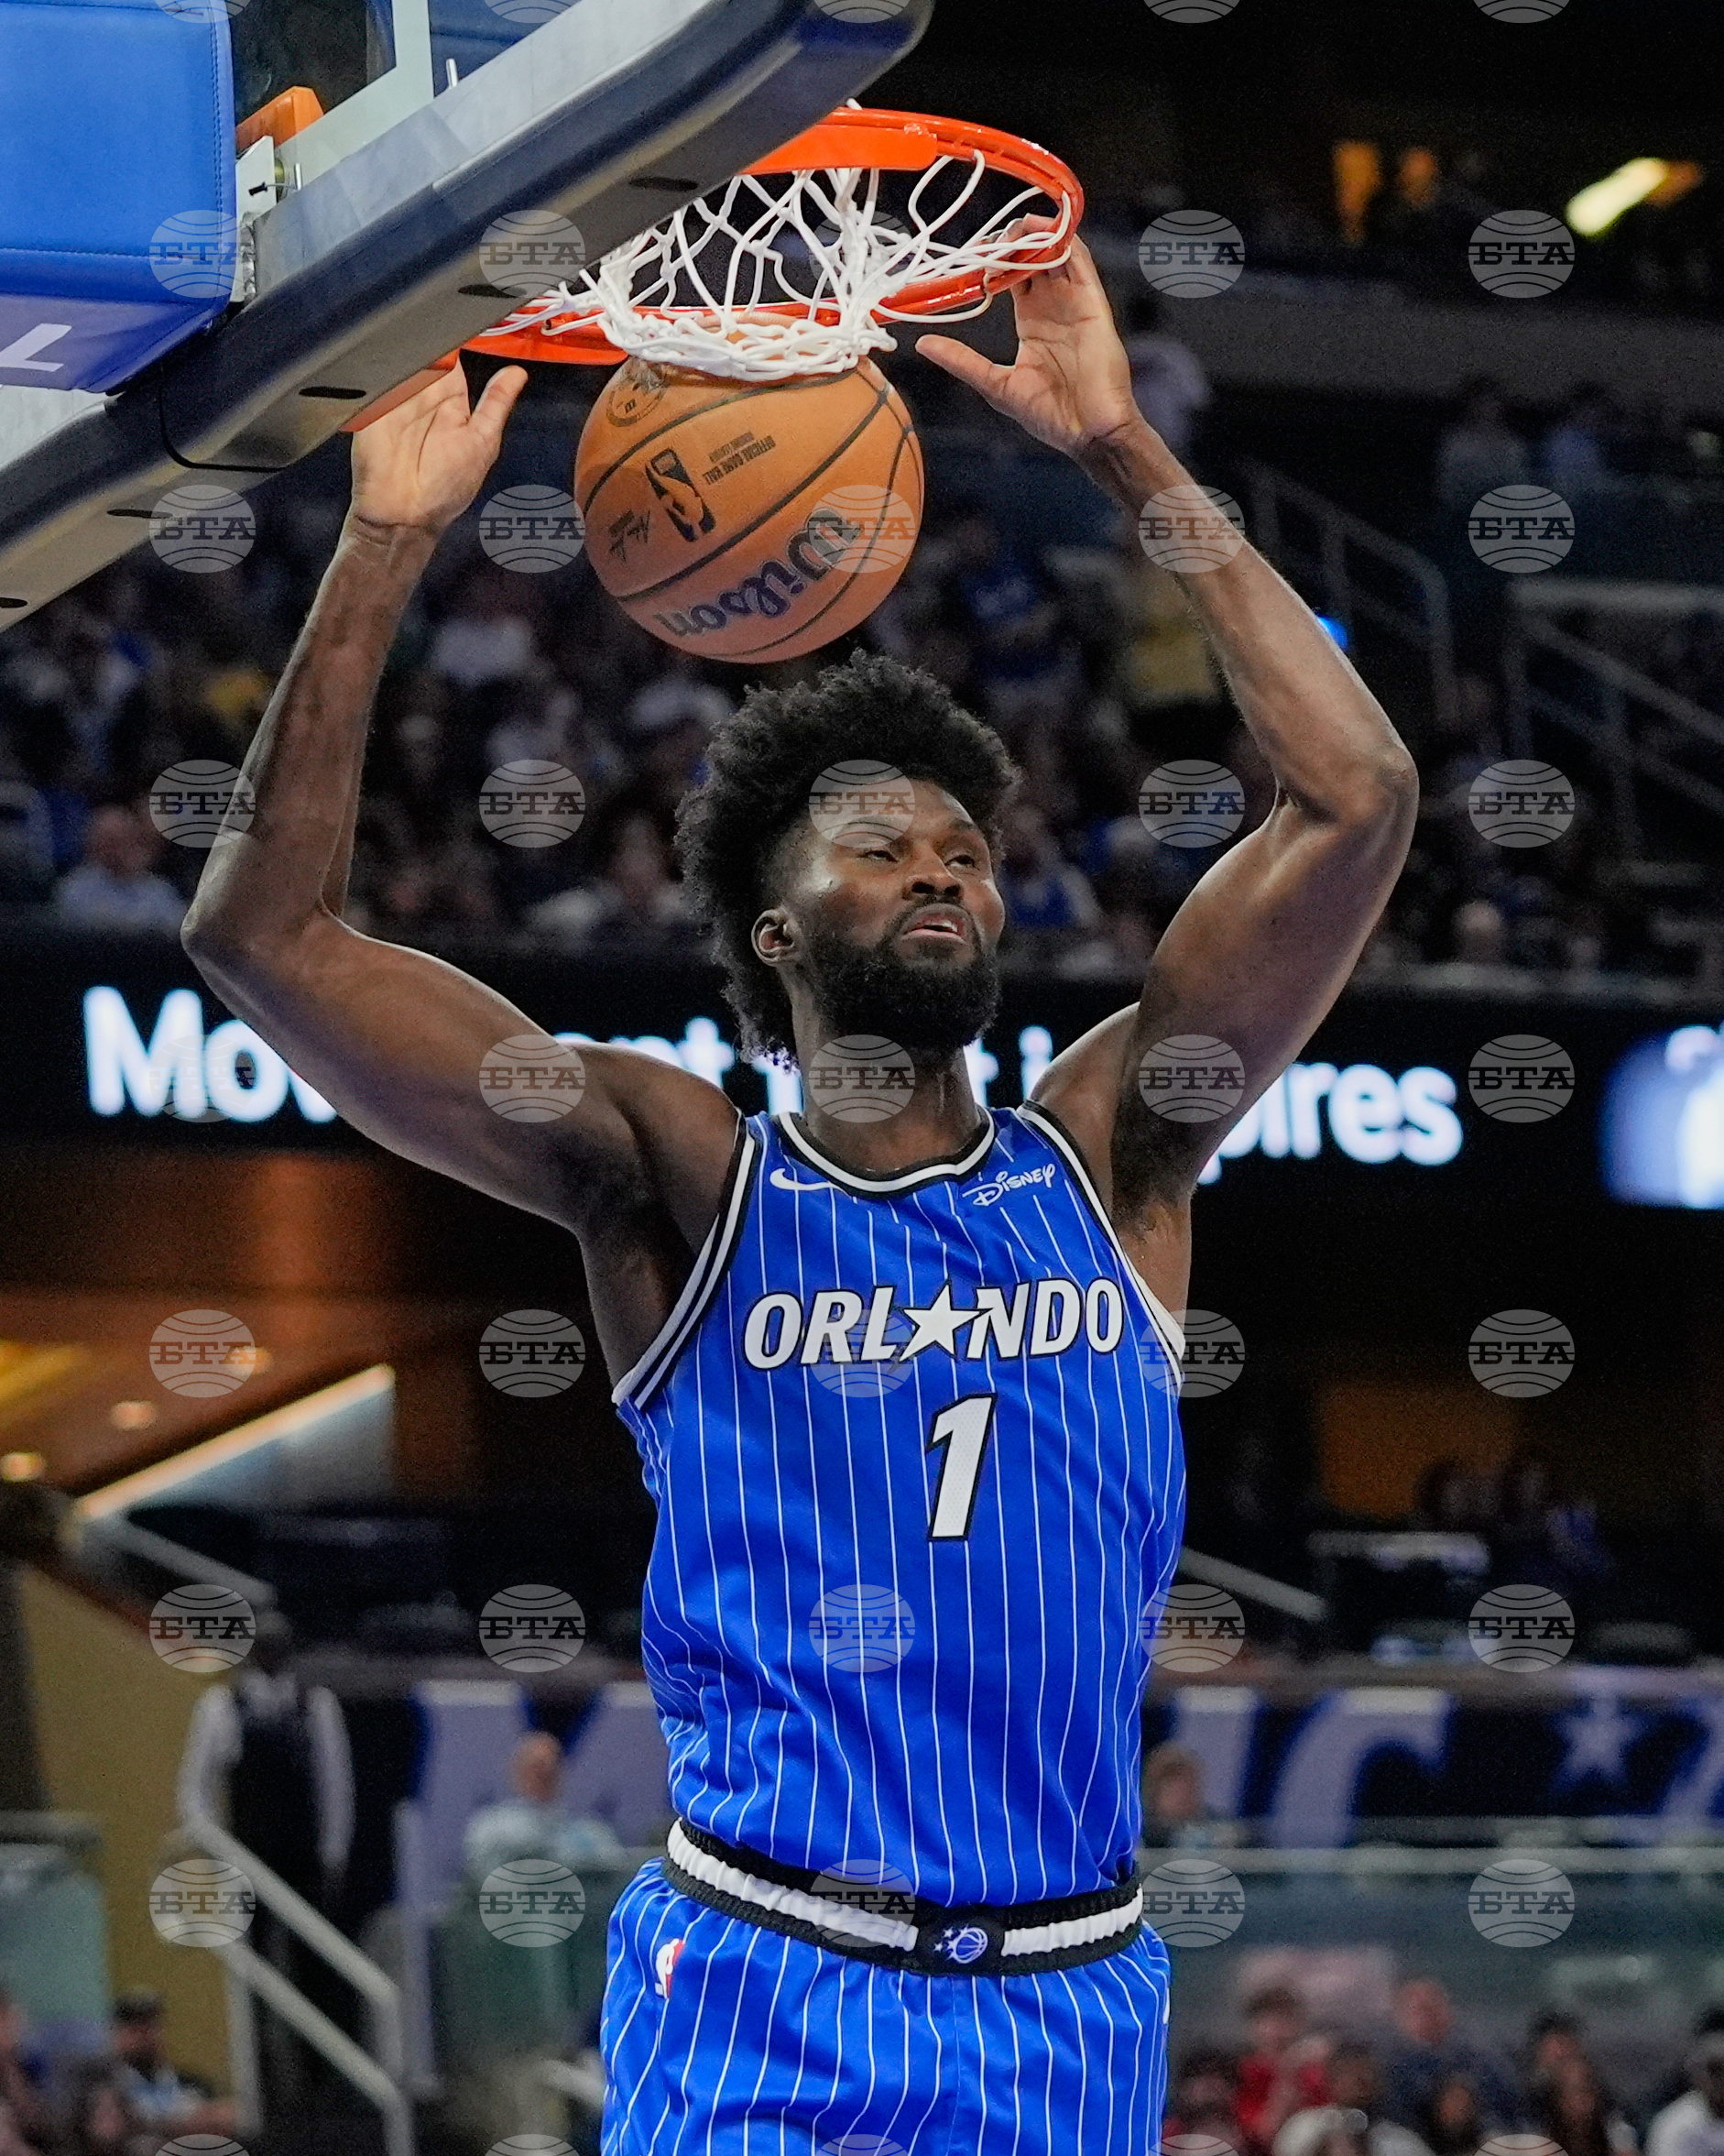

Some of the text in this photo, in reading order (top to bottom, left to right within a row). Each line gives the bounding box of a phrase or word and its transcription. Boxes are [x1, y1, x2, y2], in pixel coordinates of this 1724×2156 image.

[702, 465, 724, 486] BALL
[652, 508, 864, 638] Wilson
[923, 1392, 997, 1541] 1
